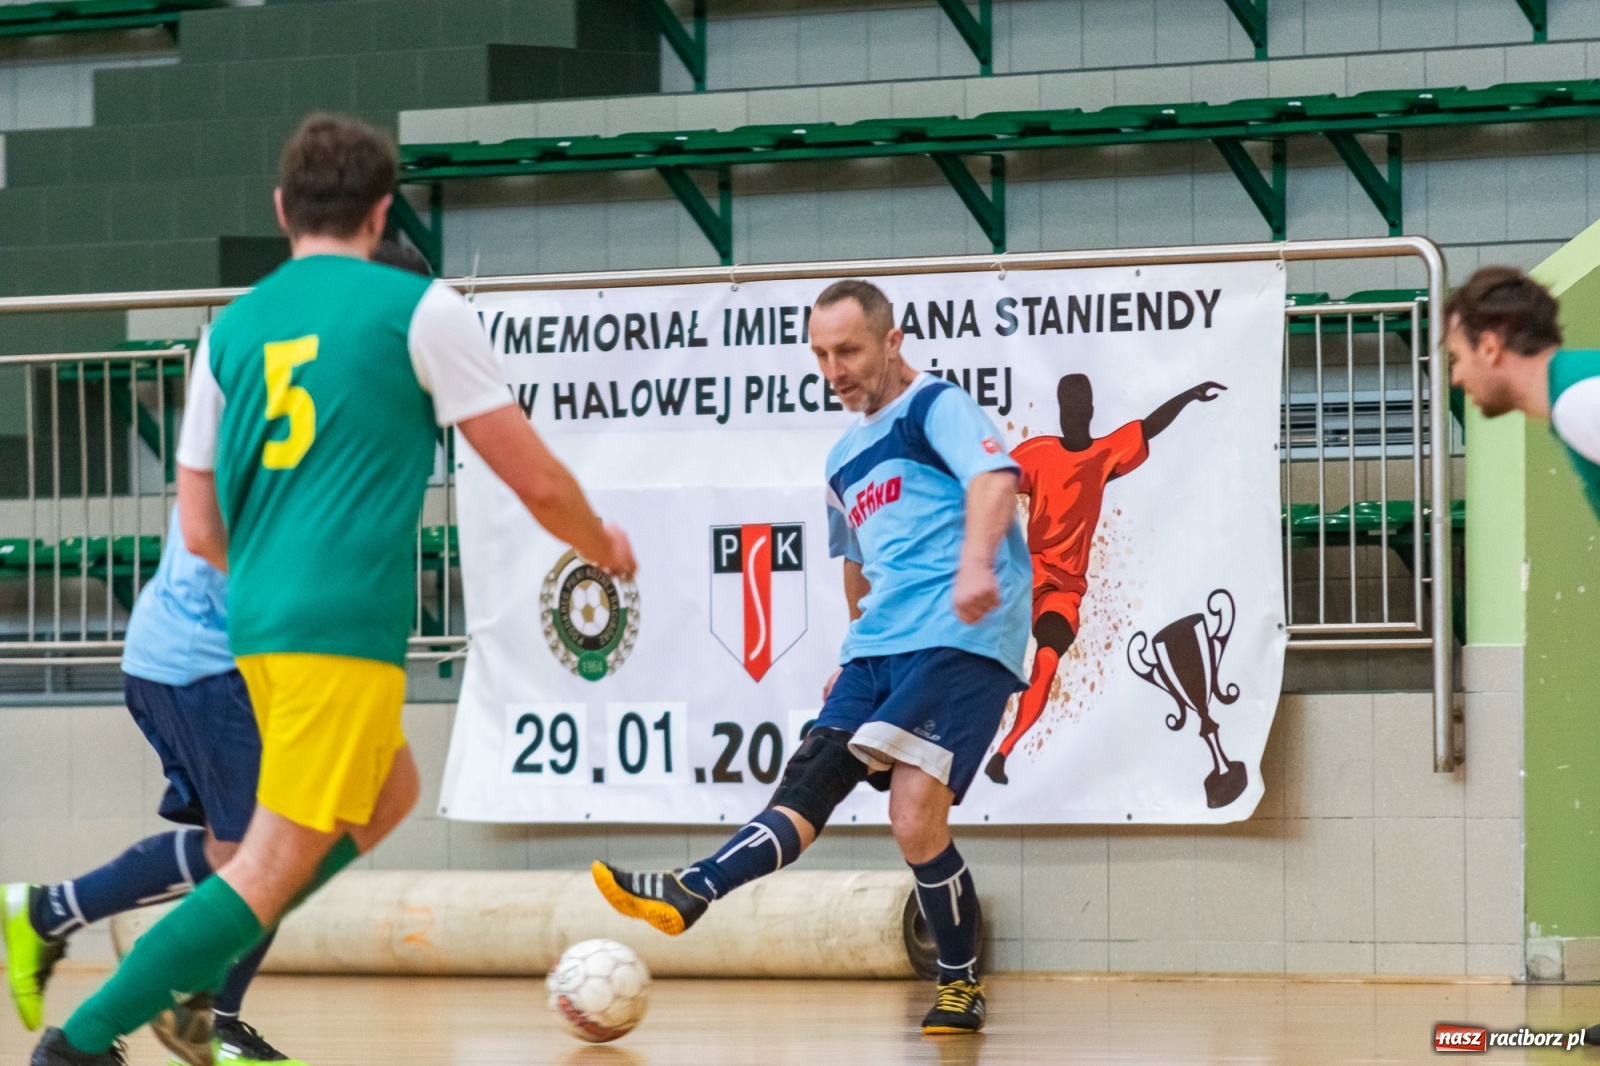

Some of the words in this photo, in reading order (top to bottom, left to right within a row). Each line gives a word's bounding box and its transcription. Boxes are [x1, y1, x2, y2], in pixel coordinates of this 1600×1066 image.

[891, 299, 981, 339] ANA
[994, 288, 1222, 336] STANIENDY
[262, 334, 319, 470] 5
[553, 376, 731, 425] HALOWEJ
[744, 373, 843, 413] PIŁCE
